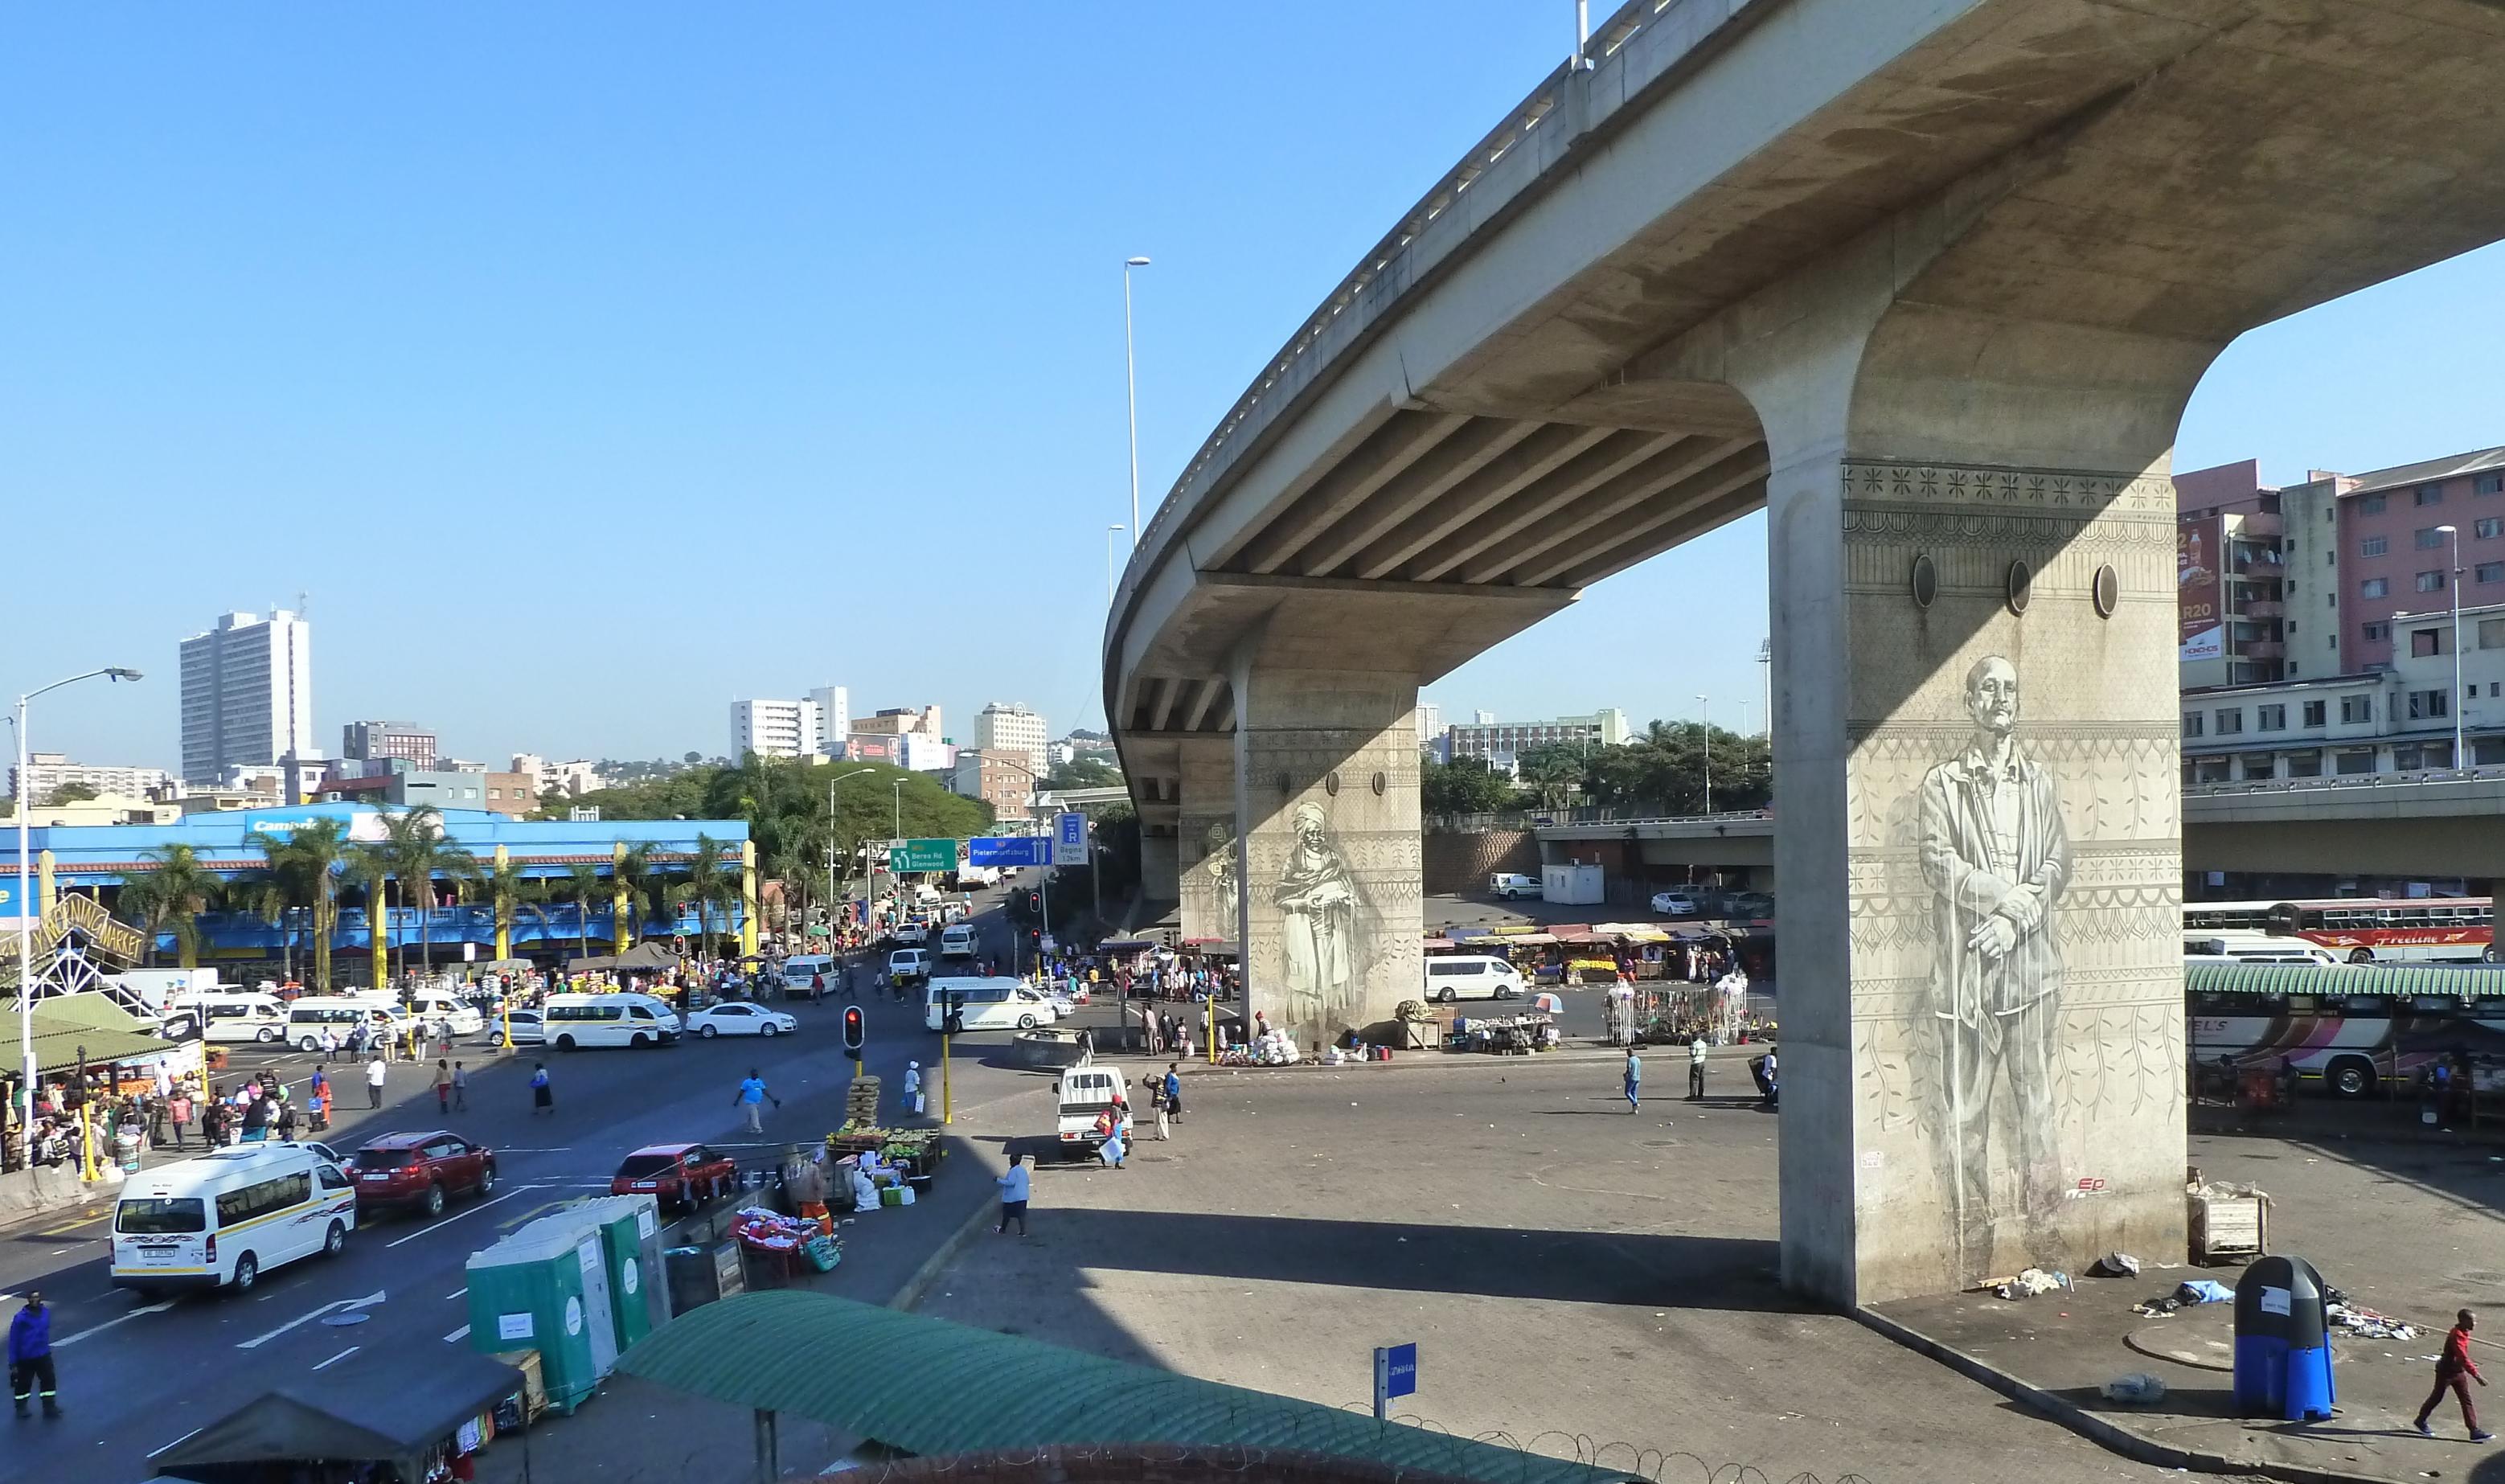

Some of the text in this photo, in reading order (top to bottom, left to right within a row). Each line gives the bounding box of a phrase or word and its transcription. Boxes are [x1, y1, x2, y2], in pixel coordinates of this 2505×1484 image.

[2183, 603, 2211, 619] R20
[47, 899, 142, 958] MORNING MARKET
